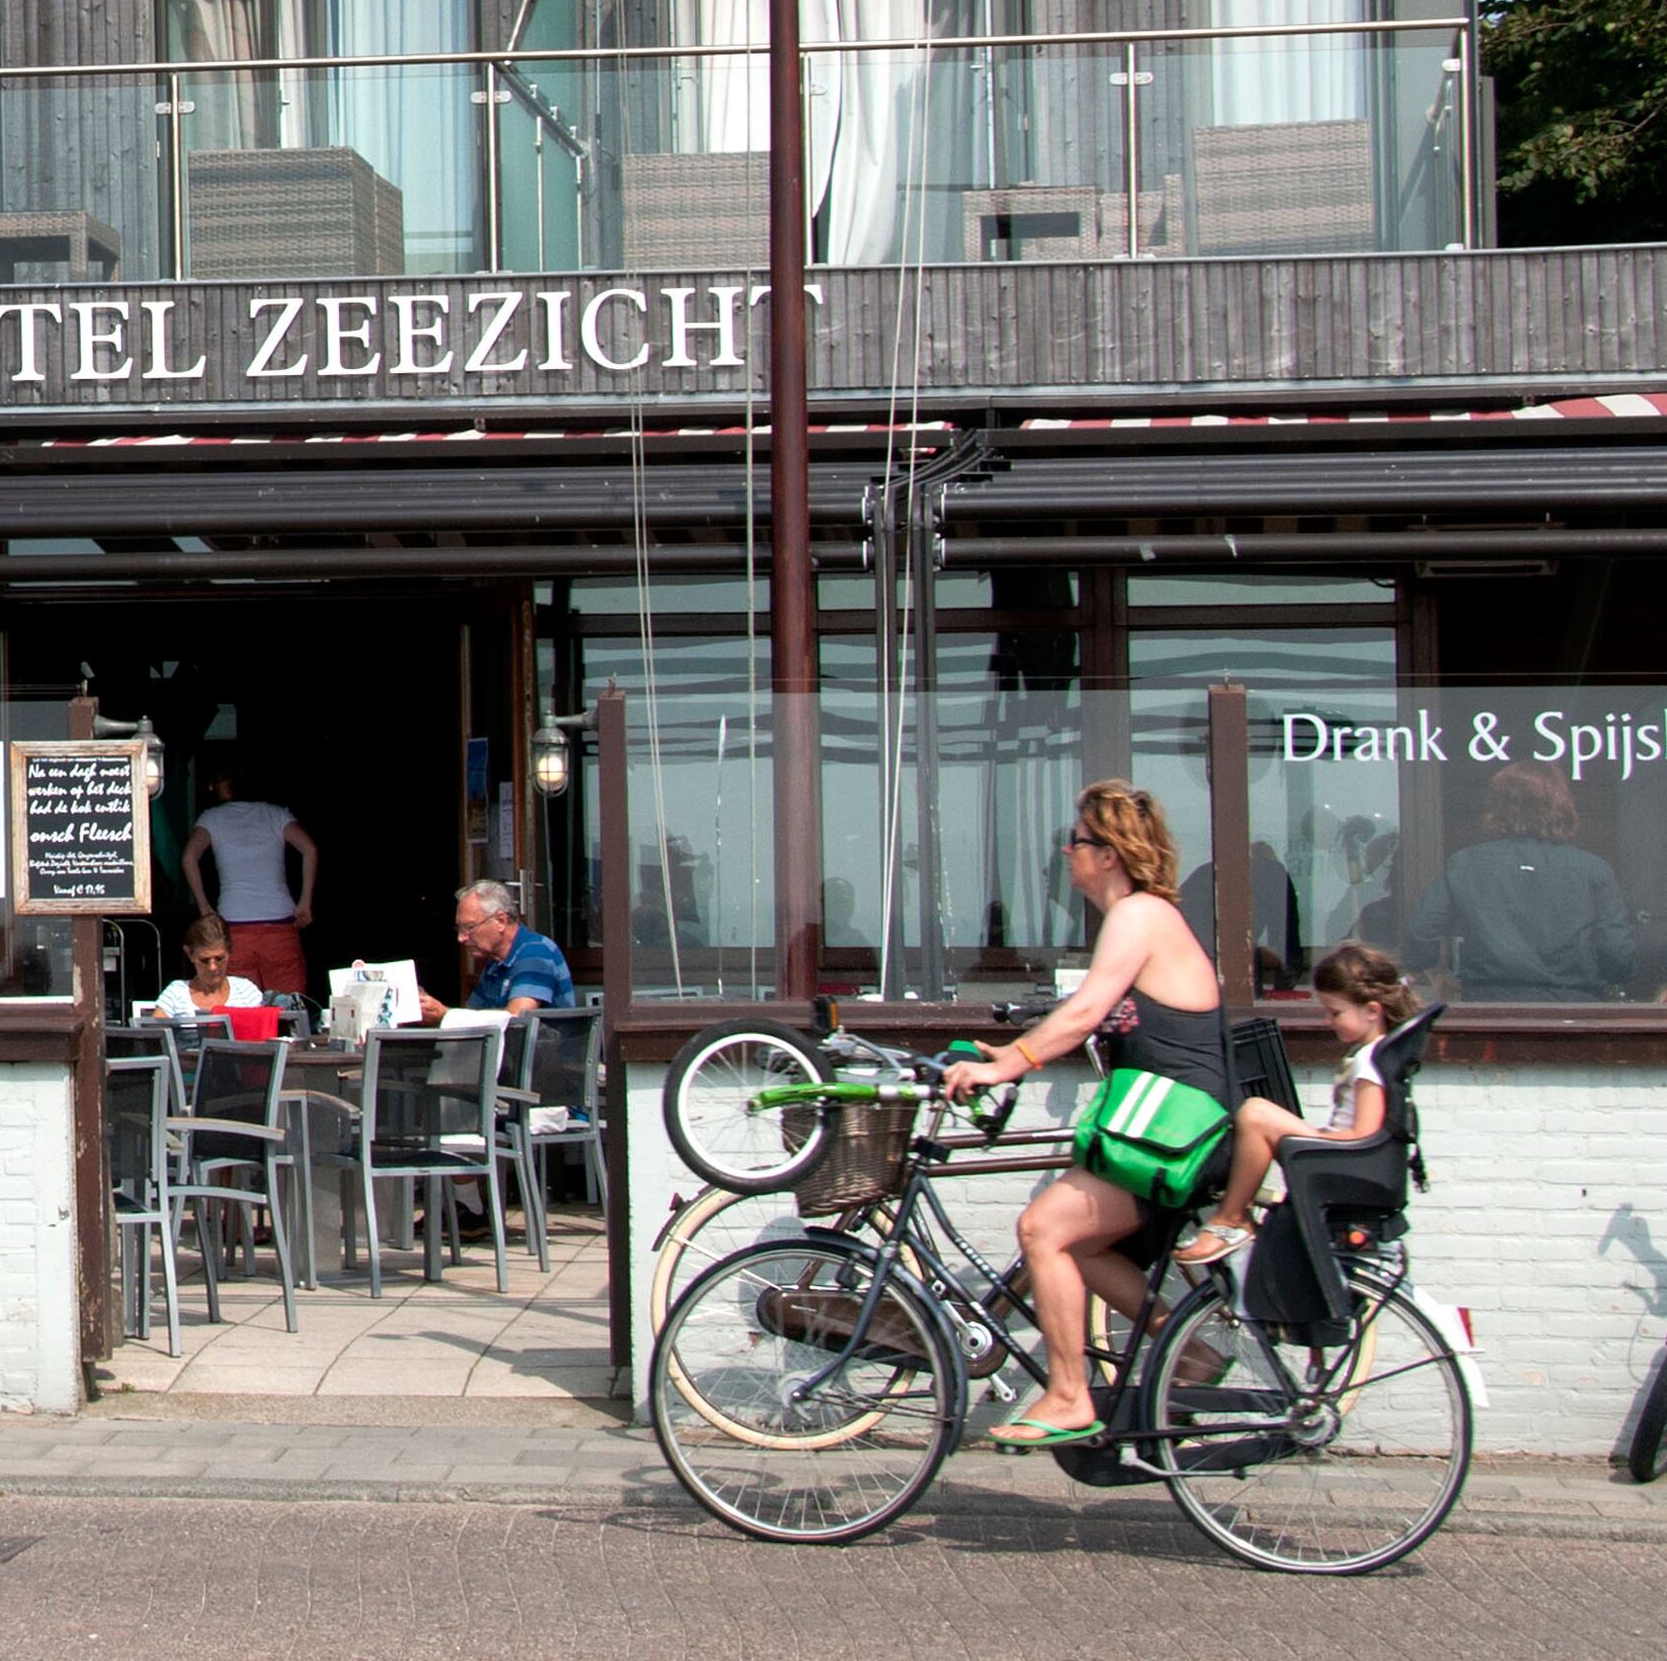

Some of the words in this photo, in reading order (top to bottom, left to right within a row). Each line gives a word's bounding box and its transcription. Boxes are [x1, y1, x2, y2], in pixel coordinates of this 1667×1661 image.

[1282, 709, 1448, 763] Drank
[1467, 711, 1511, 762] &
[28, 764, 46, 779] Na
[48, 769, 68, 778] een
[69, 763, 97, 783] dagh
[28, 782, 68, 796] werken
[70, 785, 84, 800] op
[86, 781, 105, 795] het
[106, 781, 132, 795] deck
[30, 800, 52, 815] had
[54, 800, 68, 814] de
[70, 800, 92, 814] kok
